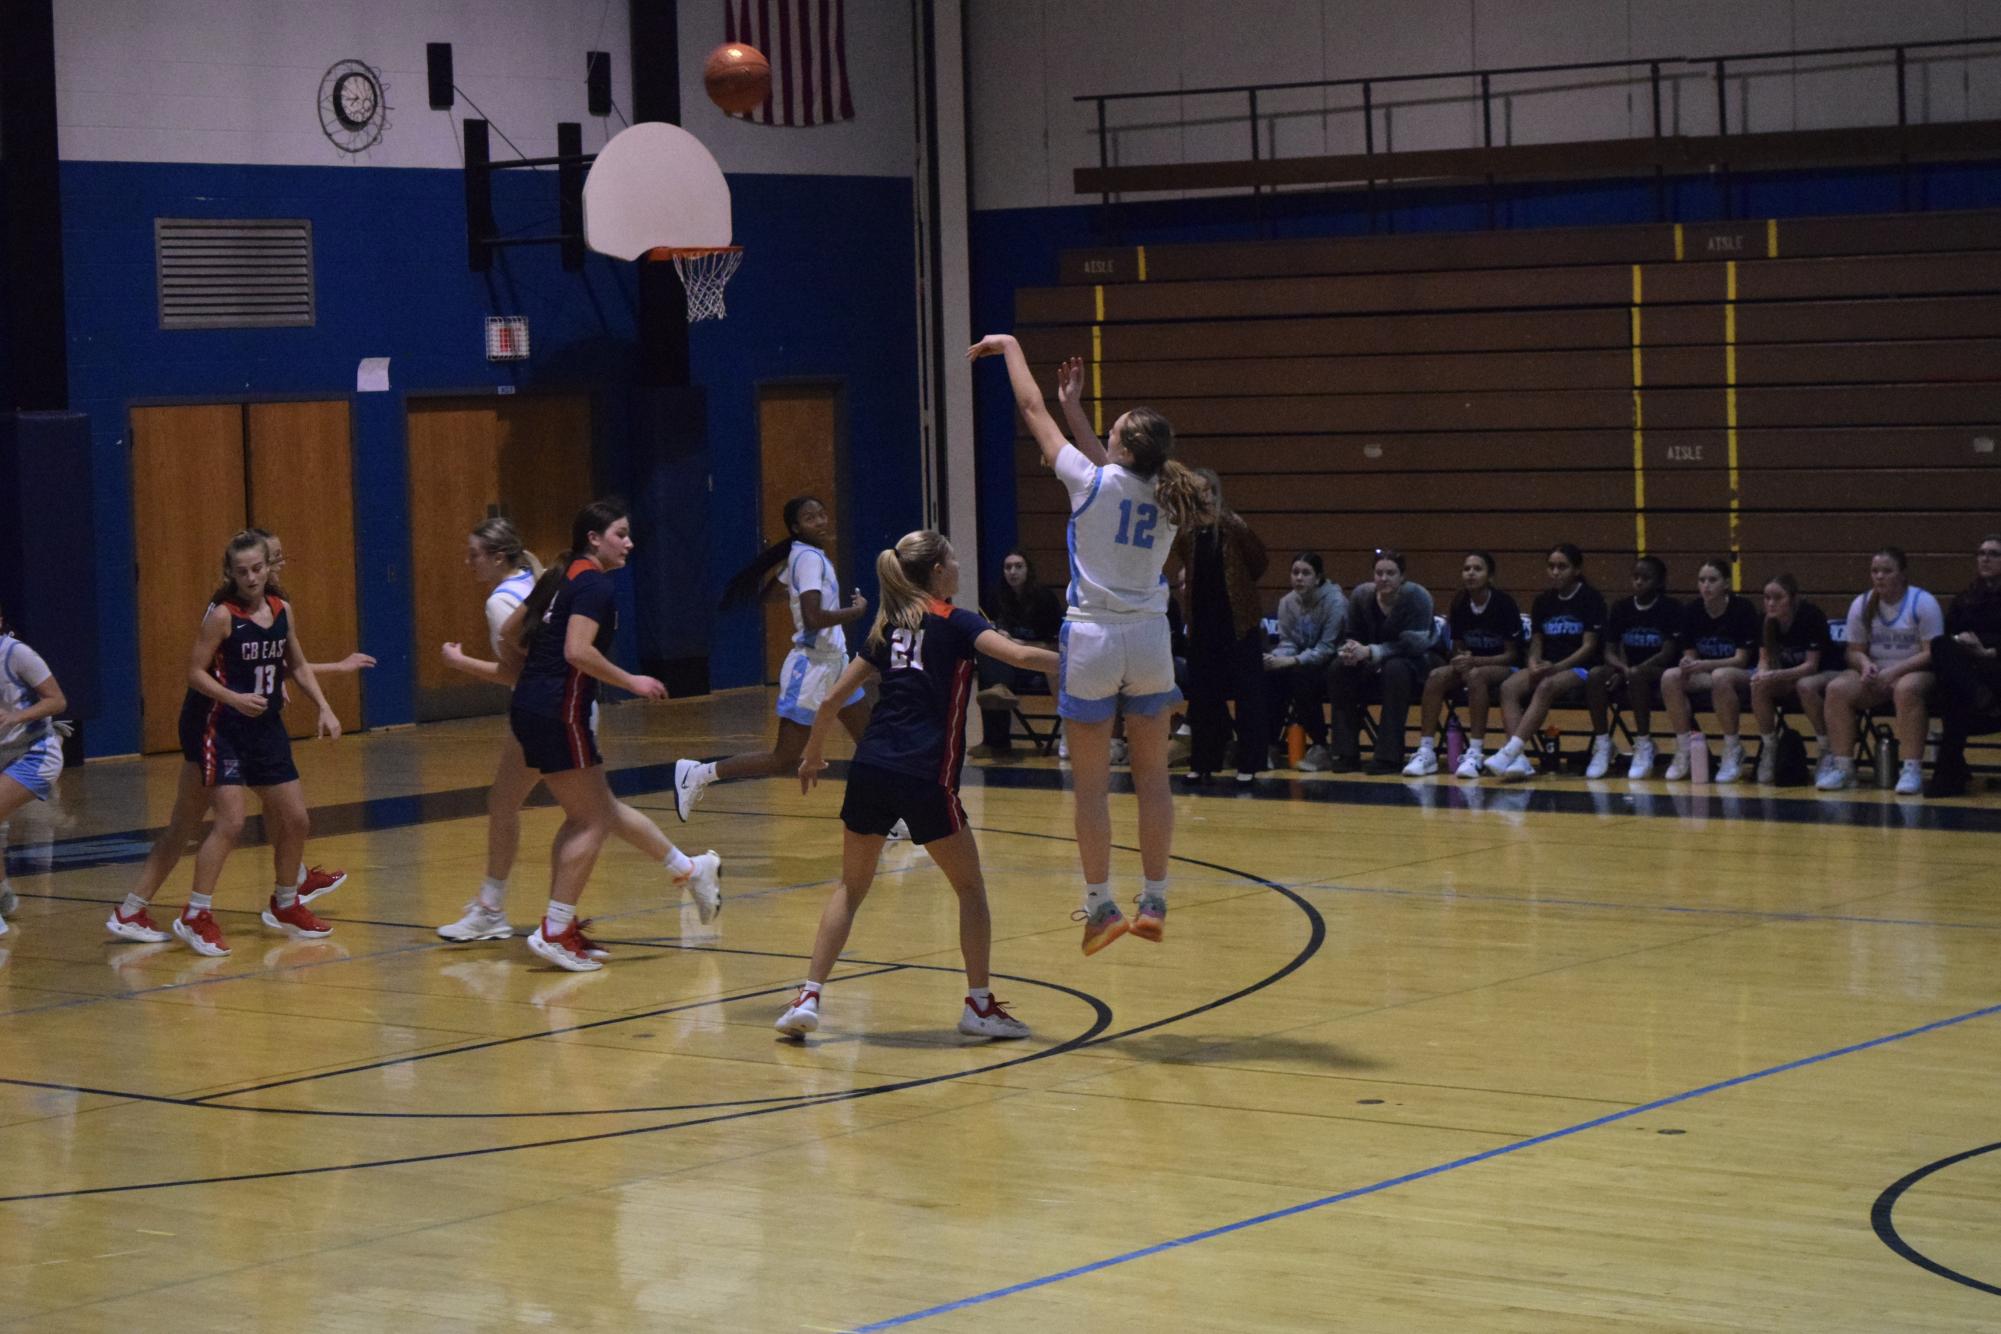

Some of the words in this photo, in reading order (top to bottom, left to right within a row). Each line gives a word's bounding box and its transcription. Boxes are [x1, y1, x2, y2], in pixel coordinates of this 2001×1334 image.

[1707, 235, 1744, 252] AISLE
[1084, 259, 1114, 273] AISLE
[1666, 445, 1704, 461] AISLE
[1115, 499, 1158, 549] 12
[242, 642, 259, 660] CB
[891, 628, 925, 671] 21
[254, 665, 276, 695] 13
